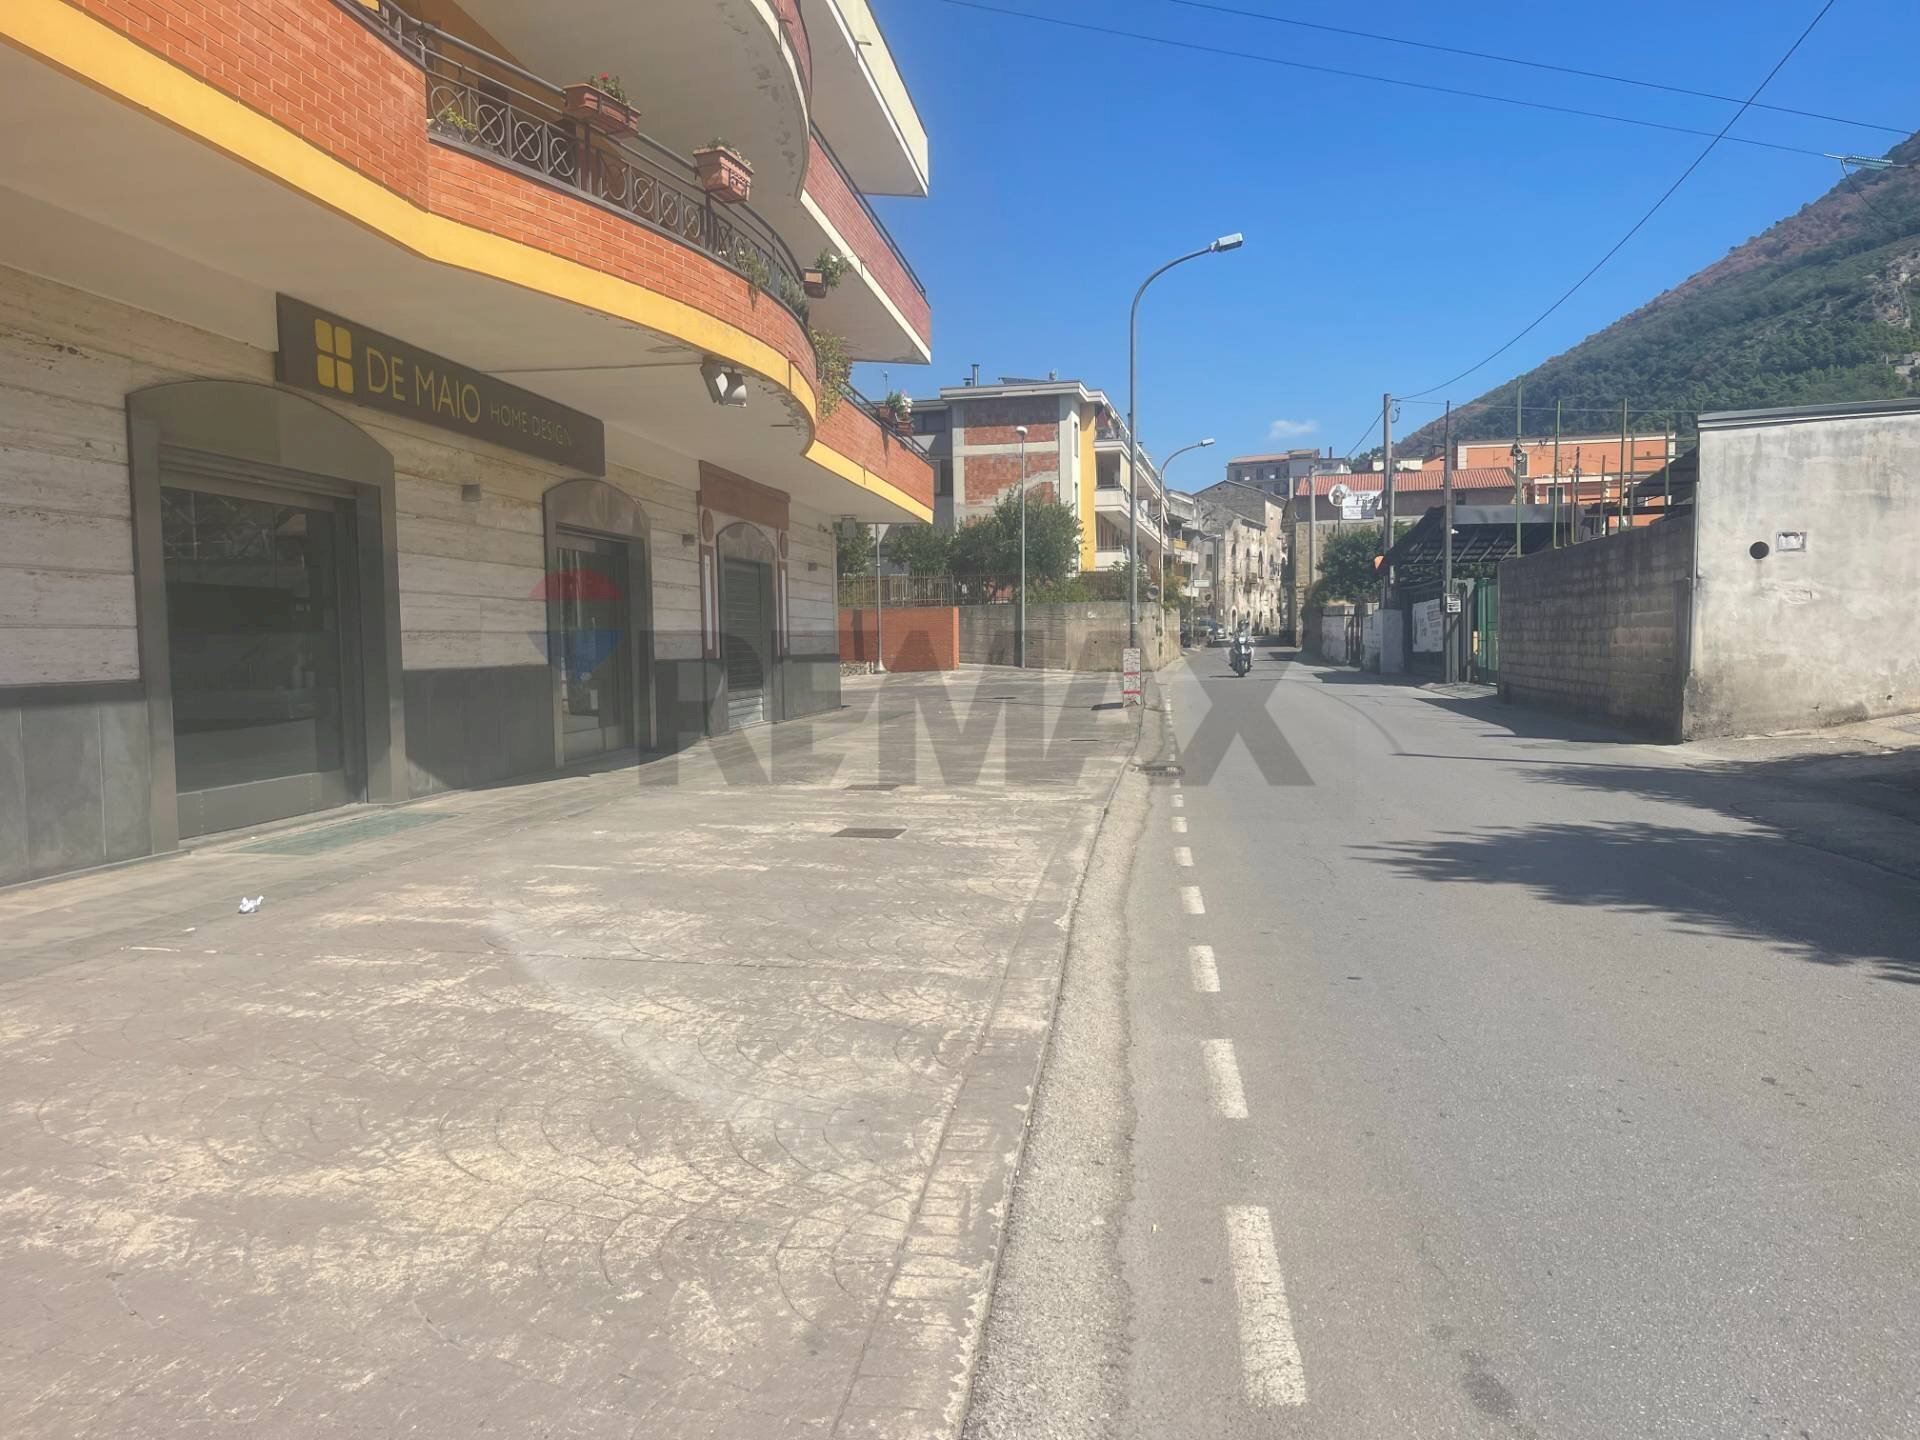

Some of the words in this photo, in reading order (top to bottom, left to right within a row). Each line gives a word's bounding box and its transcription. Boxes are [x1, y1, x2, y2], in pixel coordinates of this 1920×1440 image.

[367, 346, 406, 401] DE
[415, 364, 481, 424] MAIO
[491, 403, 528, 433] HOME
[532, 416, 573, 447] DESIGN
